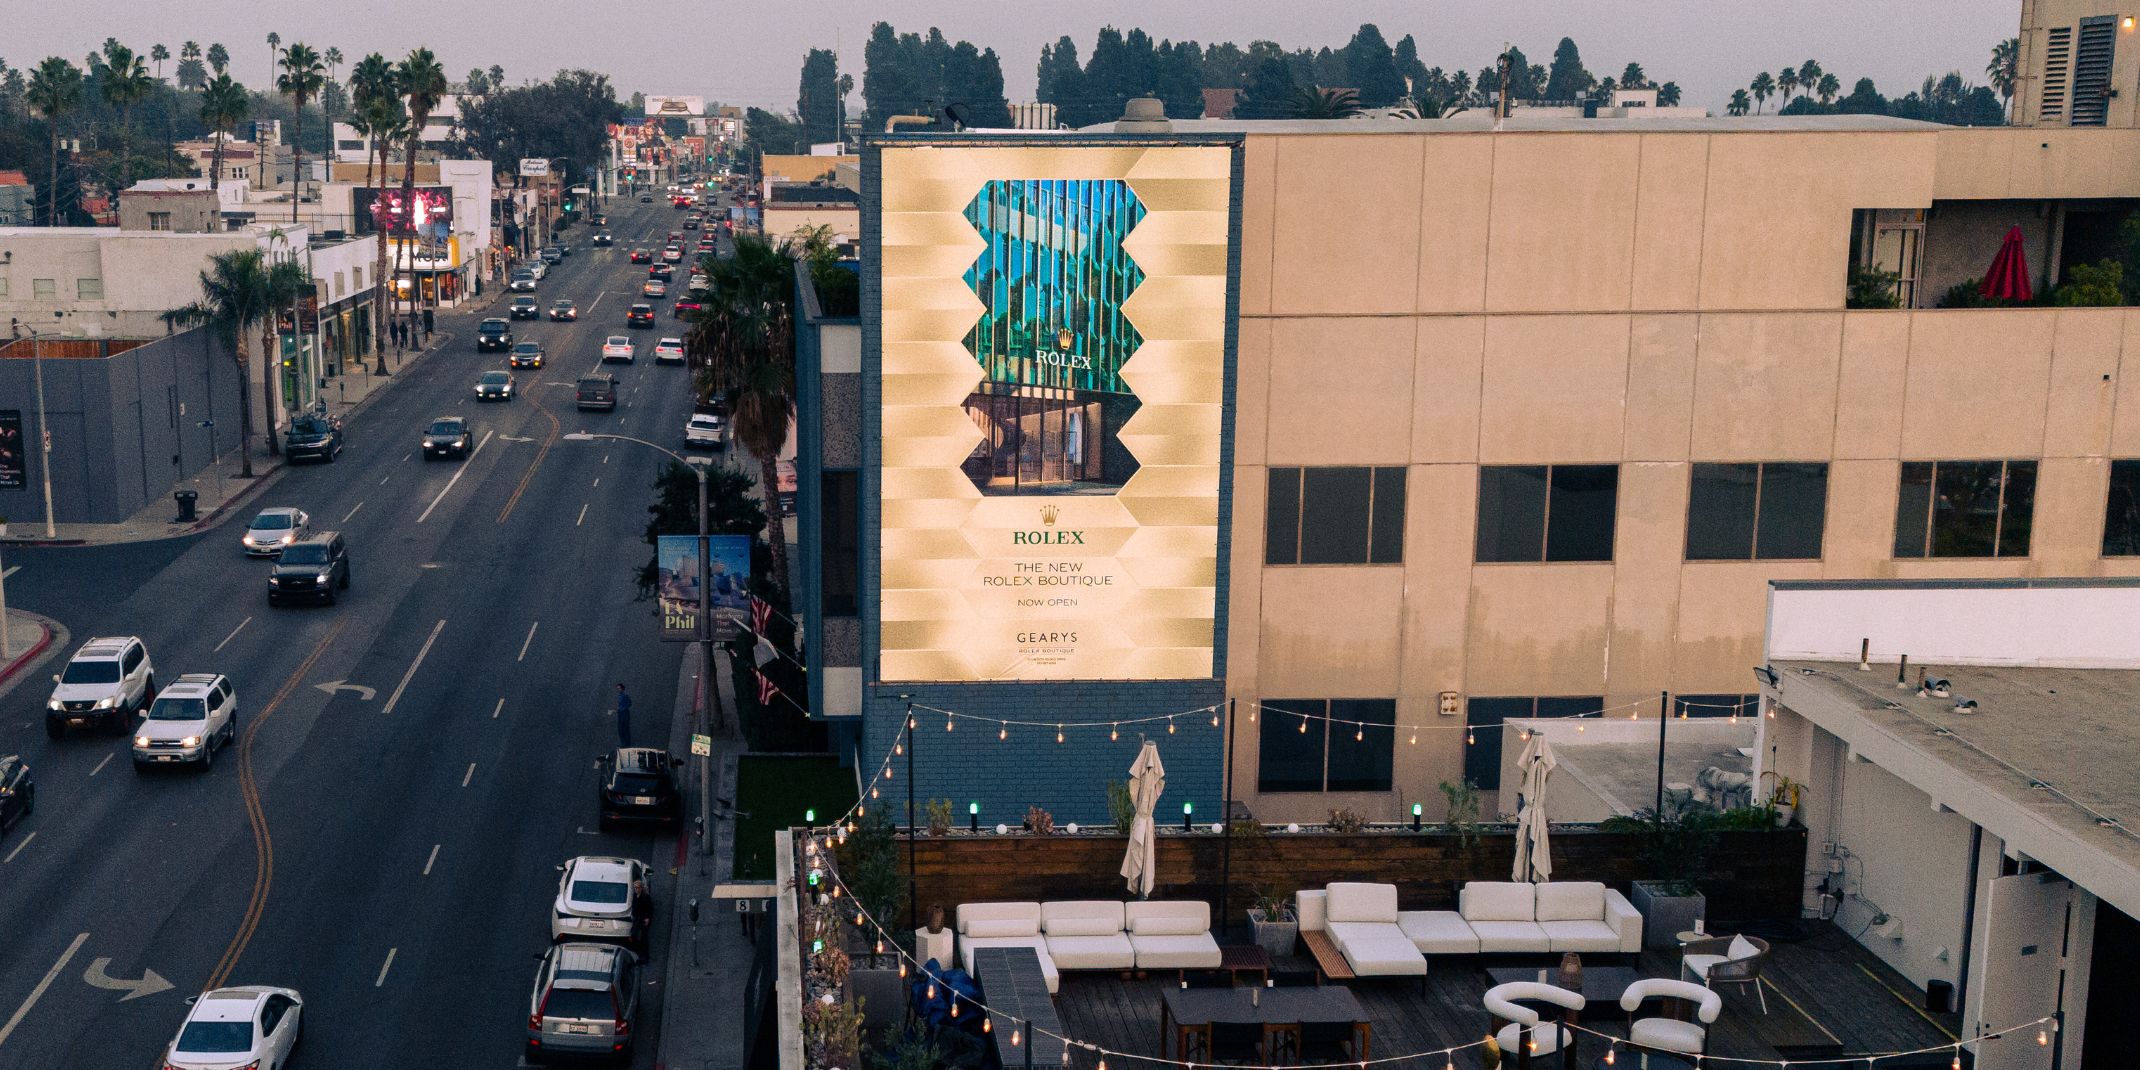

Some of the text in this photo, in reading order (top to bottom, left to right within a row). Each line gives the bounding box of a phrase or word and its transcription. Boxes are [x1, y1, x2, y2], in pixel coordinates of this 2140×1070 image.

[1035, 350, 1092, 370] ROLEX
[1013, 531, 1085, 545] ROLEX
[1015, 562, 1083, 573] THE NEW
[983, 575, 1113, 587] ROLEX BOUTIQUE
[1017, 598, 1078, 607] NOW OPEN
[665, 615, 695, 629] Phil
[1017, 632, 1078, 643] GEARYS
